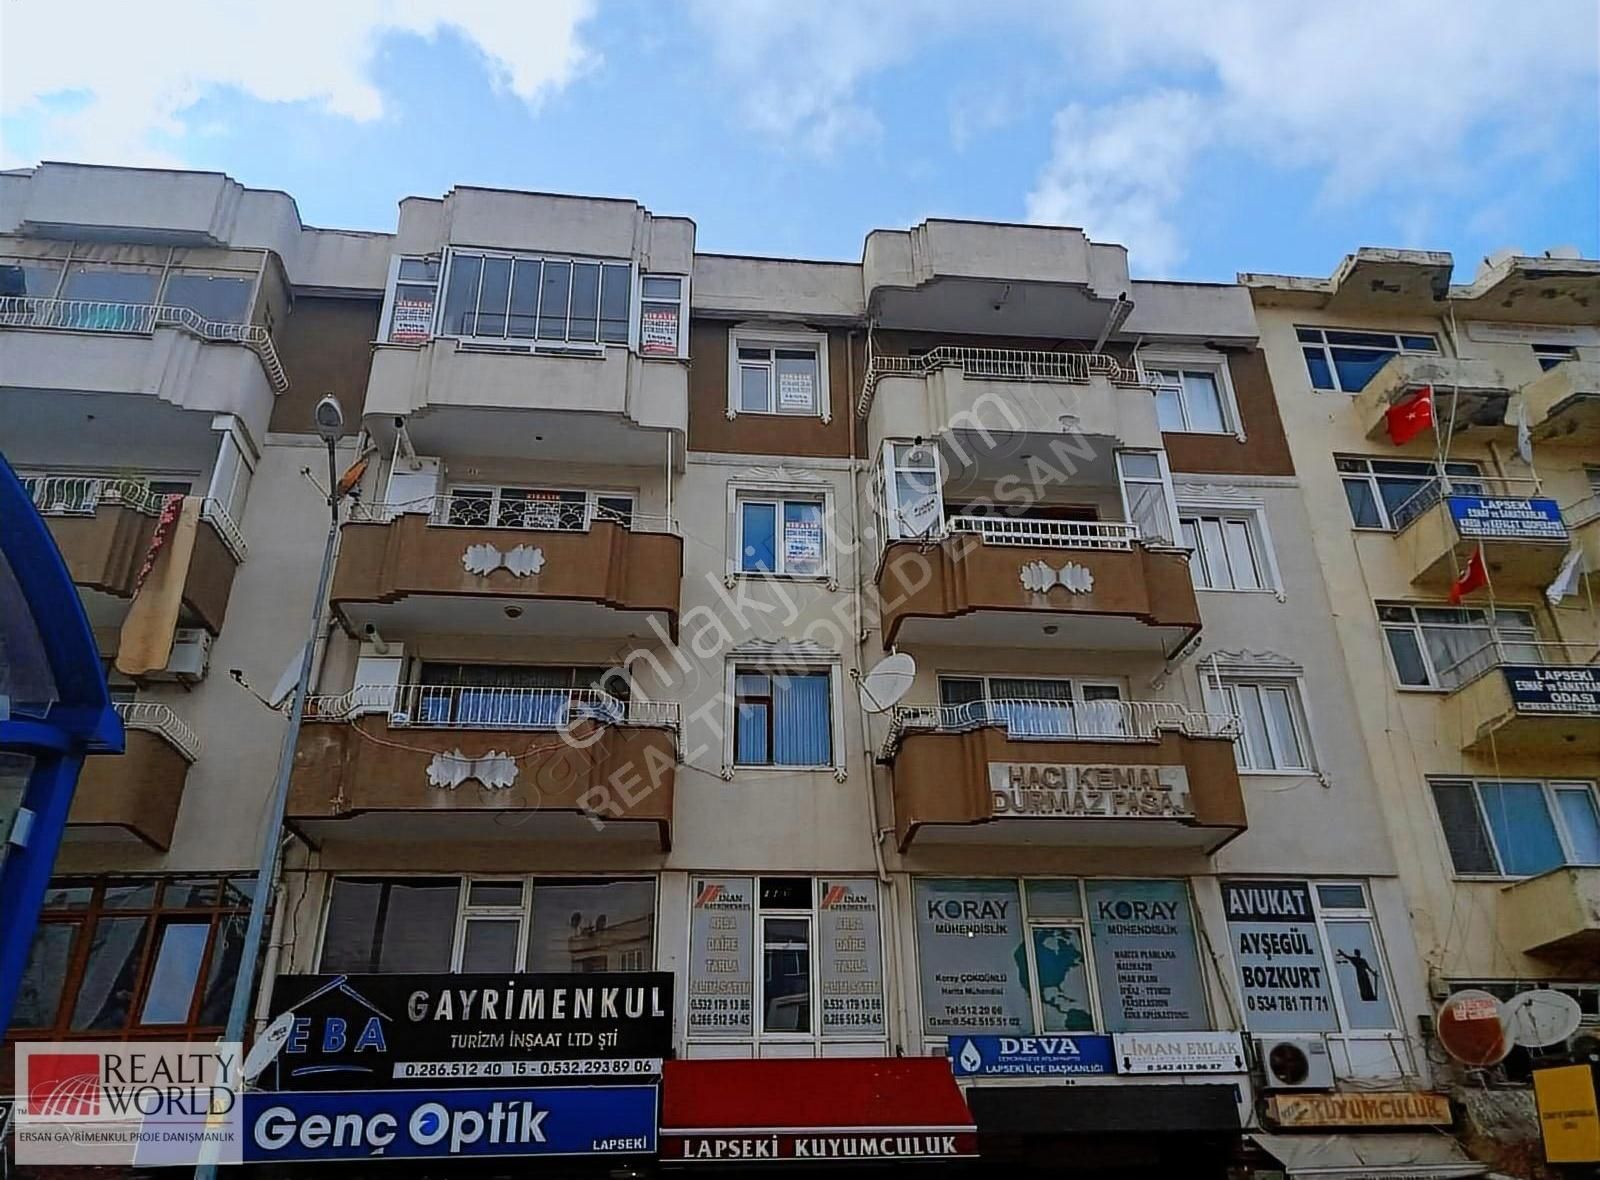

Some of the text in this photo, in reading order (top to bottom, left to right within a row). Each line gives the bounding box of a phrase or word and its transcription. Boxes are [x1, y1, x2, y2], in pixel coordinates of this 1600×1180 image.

[1550, 693, 1596, 703] ODASI
[927, 900, 1009, 919] KORAY
[1098, 900, 1178, 920] KORAY
[1230, 888, 1305, 915] AVUKAT
[935, 923, 1008, 934] MÜHENDİSLİK
[1107, 923, 1178, 935] MÜHENDİSLİK
[1240, 927, 1314, 960] AYŞEGÜL
[1242, 966, 1320, 988] BOZKURT
[407, 981, 665, 1023] GAYRİMENKUL
[1248, 995, 1329, 1011] 0 534 781 77 71
[286, 1016, 387, 1054] EBA
[451, 1028, 618, 1052] TURİZM İNŞAAT LTD ŞTİ
[999, 1038, 1080, 1055] DEVA
[1121, 1038, 1238, 1056] LİMAN EMLAK
[405, 1062, 478, 1076] 0.286.512
[484, 1062, 501, 1075] 40
[512, 1062, 526, 1075] 15
[634, 1061, 652, 1074] 06
[1026, 1063, 1048, 1075] İLÇE
[1311, 1099, 1444, 1119] KUYUMCULUK
[254, 1101, 550, 1155] Genç Optik
[593, 1136, 647, 1151] LAPSEKİ
[684, 1134, 958, 1158] LAPSEKİ KUYUMCULUK
